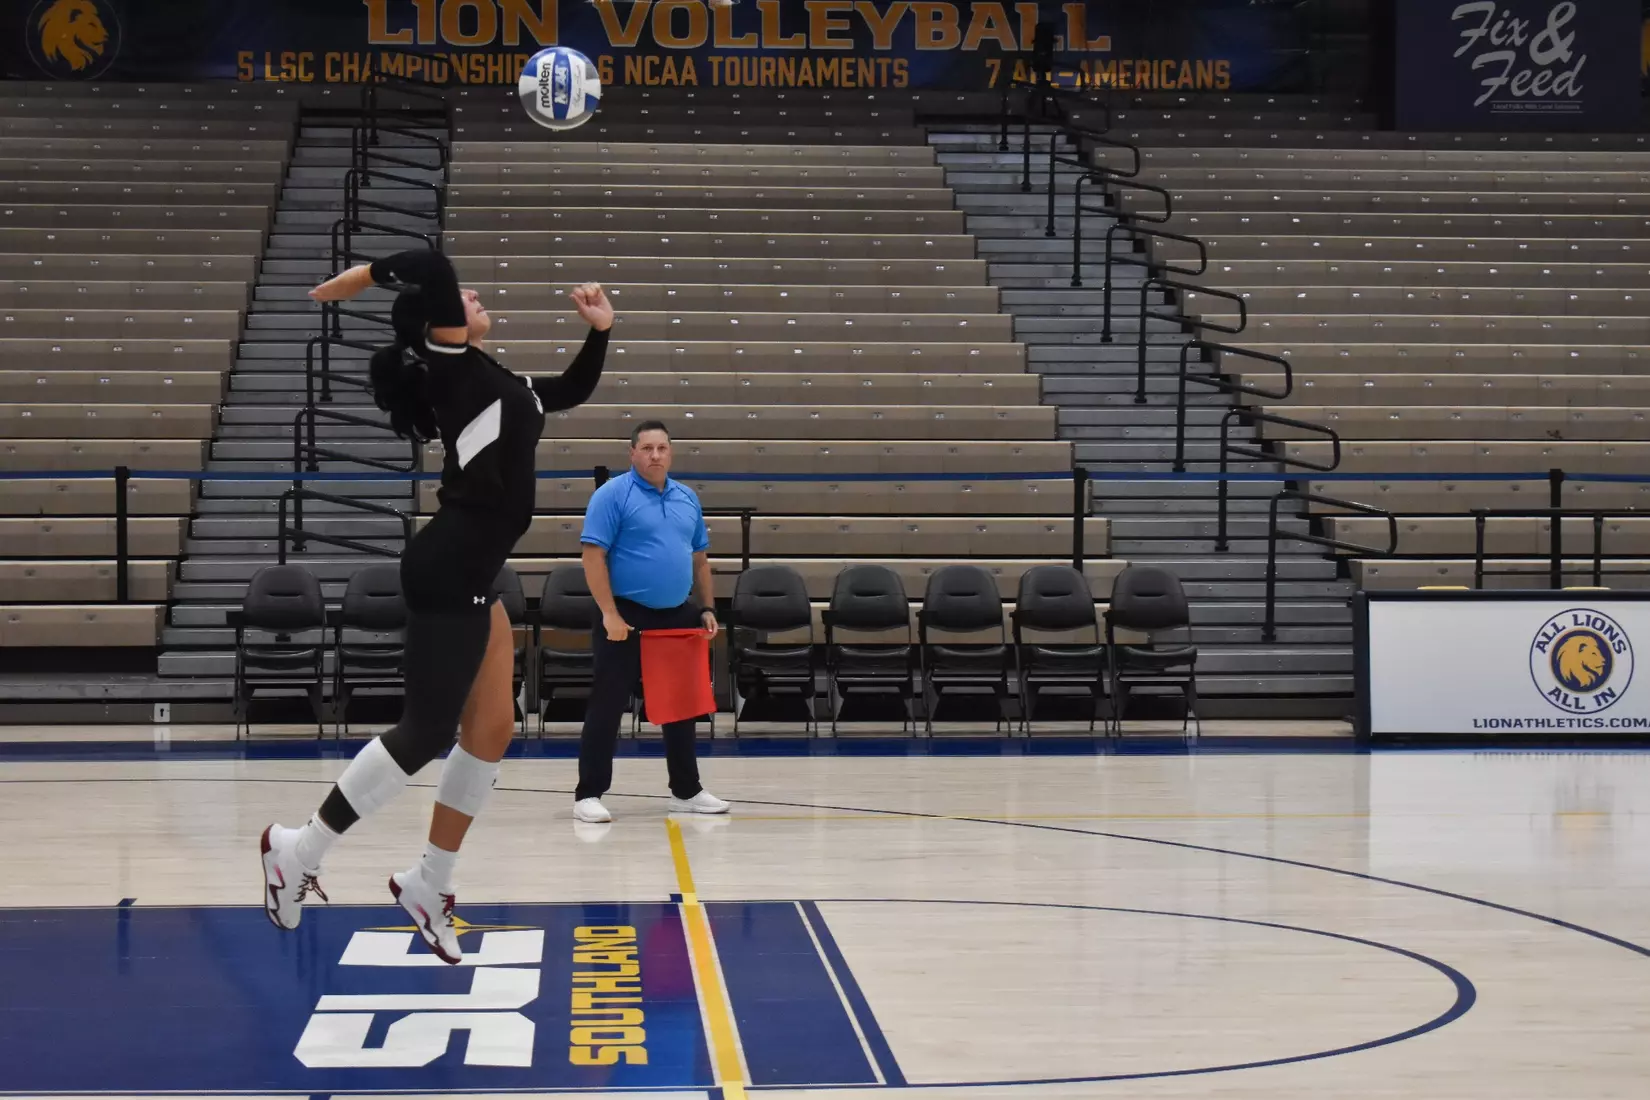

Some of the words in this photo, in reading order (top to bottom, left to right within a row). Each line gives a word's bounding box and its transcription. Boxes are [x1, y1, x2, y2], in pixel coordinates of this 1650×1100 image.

[364, 0, 559, 47] LION
[593, 0, 1112, 52] VOLLEYBALL
[1451, 1, 1529, 58] Fix
[1529, 1, 1577, 66] &
[237, 50, 254, 83] 5
[264, 50, 315, 83] LSC
[324, 51, 531, 84] CHAMPIONSHIP
[597, 54, 614, 85] 6
[624, 55, 698, 86] NCAA
[708, 55, 909, 88] TOURNAMENTS
[985, 58, 1002, 89] 7
[539, 63, 551, 108] molten
[1471, 50, 1587, 107] Feed
[1535, 622, 1566, 654] ALL
[1572, 613, 1627, 655] LIONS
[1547, 686, 1586, 710] ALL
[1592, 686, 1617, 707] IN
[1473, 718, 1650, 729] LIONATHLETICS.COM
[568, 925, 649, 1065] SOUTHLAND
